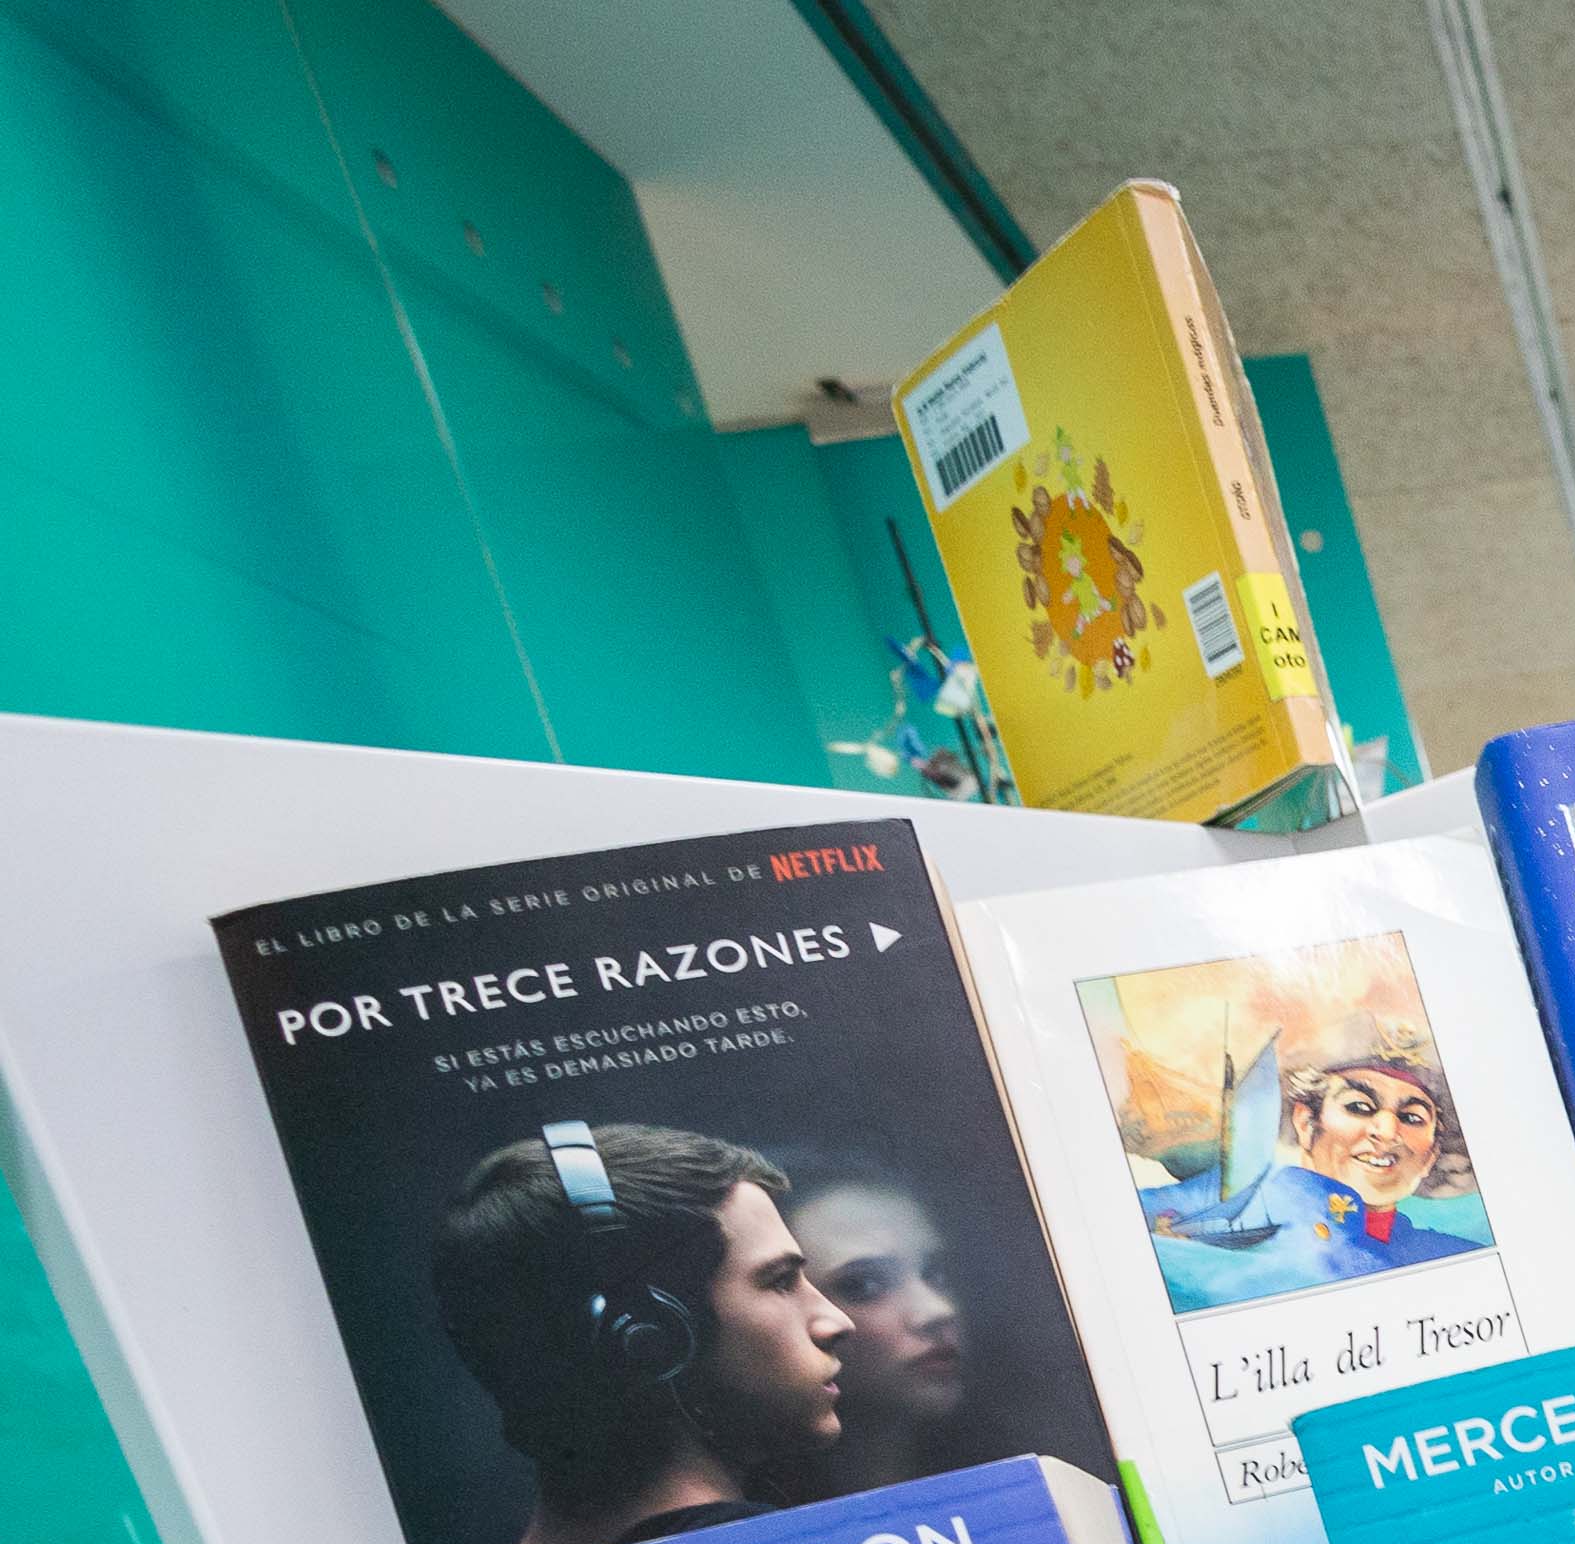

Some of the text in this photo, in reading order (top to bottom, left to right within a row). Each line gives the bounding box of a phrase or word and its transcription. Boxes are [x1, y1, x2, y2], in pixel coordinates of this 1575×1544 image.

[255, 843, 886, 957] EL LIBRO DE LA SERIE ORIGINAL DE NETFLIX
[277, 924, 851, 1046] POR TRECE RAZONES
[434, 1000, 808, 1074] SI ESTÁS ESCUCHANDO ESTO,
[463, 1027, 795, 1095] YA ES DEMASIADO TARDE.
[1336, 1326, 1386, 1376] del
[1405, 1307, 1512, 1362] Tresor
